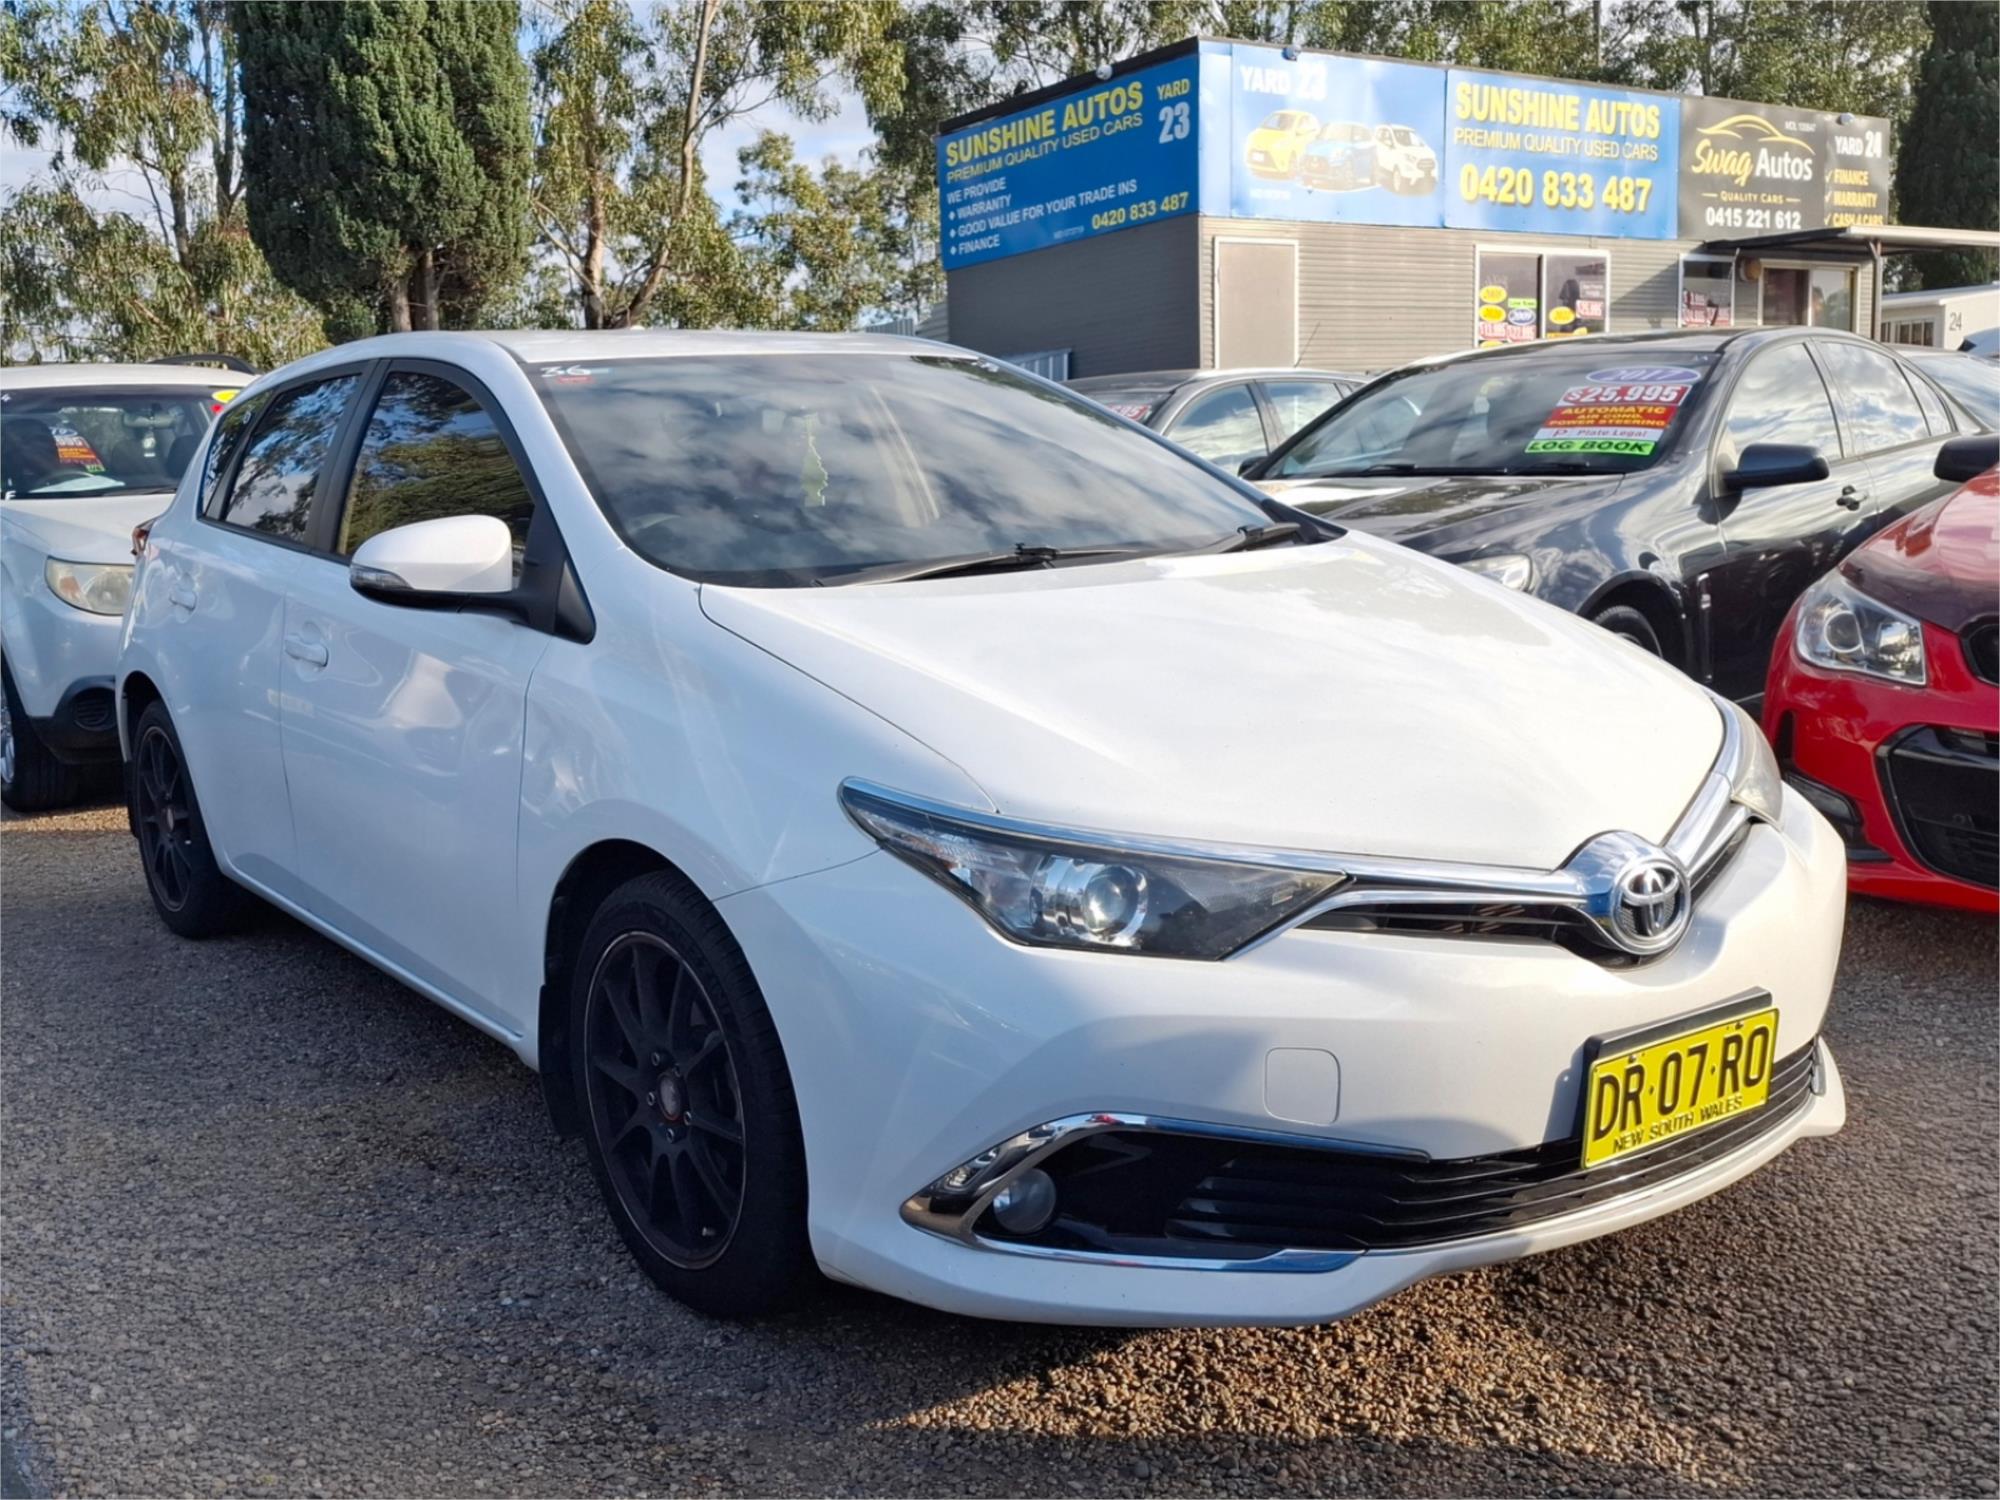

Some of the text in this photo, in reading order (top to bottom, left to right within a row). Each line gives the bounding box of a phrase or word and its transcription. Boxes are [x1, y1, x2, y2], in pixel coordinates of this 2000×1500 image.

[1157, 78, 1190, 101] YARD
[1239, 64, 1291, 96] YARD
[1159, 101, 1190, 144] 23
[1455, 81, 1660, 139] SUNSHINE AUTOS
[946, 81, 1143, 167] SUNSHINE AUTOS
[947, 112, 1143, 184] PREMIUM QUALITY USED CARS
[1454, 127, 1658, 161] PREMIUM QUALITY USED CARS
[1834, 130, 1882, 158] YARD 24
[1691, 138, 1813, 187] Swag Autos
[946, 176, 1007, 204] WE PROVIDE
[1460, 163, 1653, 213] 0420 833 487
[1834, 168, 1869, 186] FINANCE
[956, 193, 1012, 219] WARRANTY
[958, 178, 1137, 237] GOOD VALUE FOR YOUR TRADE INS
[1720, 190, 1783, 204] QUALITY CARS
[1833, 190, 1878, 208] WARRANTY
[1092, 191, 1189, 230] 0420 833 487
[1705, 206, 1801, 230] 0415 221 612
[958, 233, 1000, 255] FINANCE
[1948, 311, 1963, 331] 24
[1606, 368, 1682, 381] 2017
[1566, 385, 1681, 403] $25,995
[1561, 405, 1667, 414] AUTOMATIC
[1553, 429, 1648, 438] P Plate Legal
[1598, 419, 1666, 427] STEERING
[1528, 441, 1650, 453] LOG BOOK
[1613, 1096, 1742, 1154] NEW SOUTH WALES
